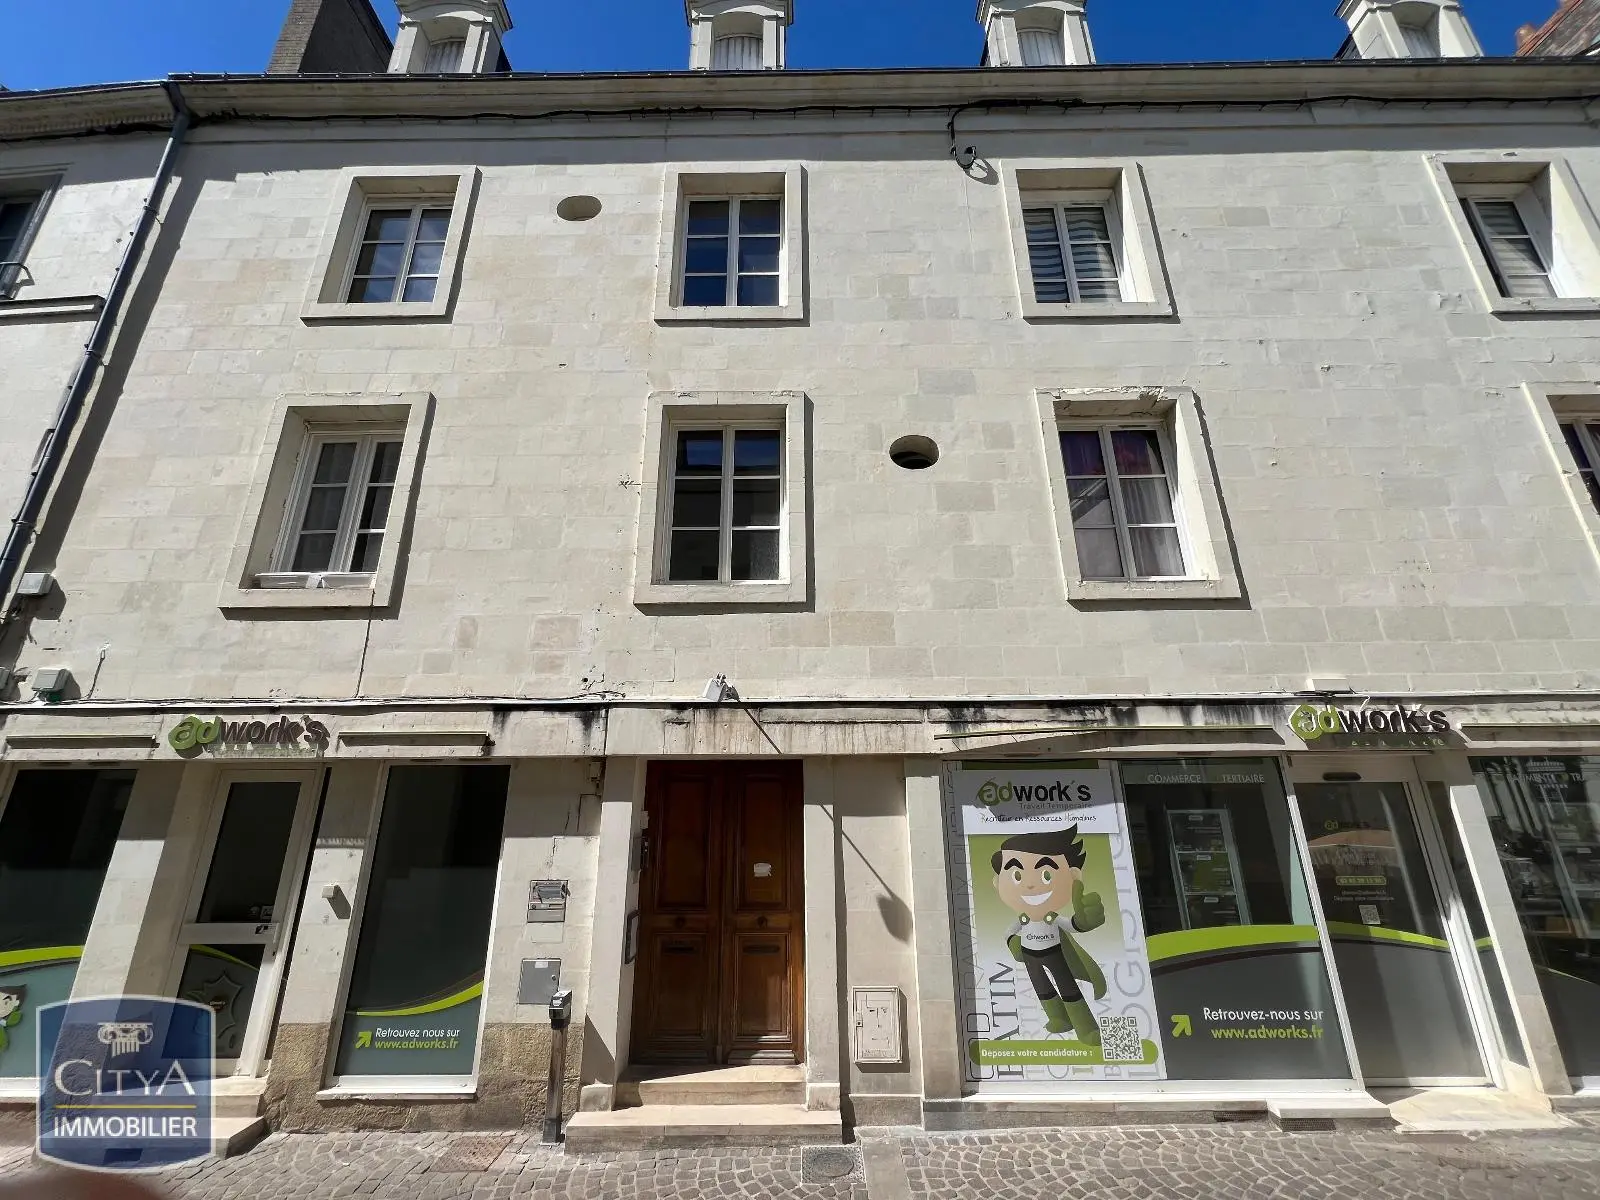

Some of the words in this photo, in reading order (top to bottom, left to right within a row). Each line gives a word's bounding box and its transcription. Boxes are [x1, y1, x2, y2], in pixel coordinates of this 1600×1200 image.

[1147, 774, 1201, 783] COMMERCE
[1222, 774, 1265, 783] TERTIAIRE
[977, 777, 1092, 807] adwork's
[1203, 1007, 1301, 1021] Retrouvez-nous
[1304, 1010, 1324, 1021] sur
[375, 1027, 420, 1038] Retrouvez
[422, 1028, 445, 1038] nous
[446, 1028, 461, 1038] sur
[1211, 1024, 1324, 1039] www.adworks.fr
[374, 1037, 459, 1049] www.adworks.fr
[1017, 1049, 1038, 1057] votre
[1040, 1049, 1088, 1057] candidature
